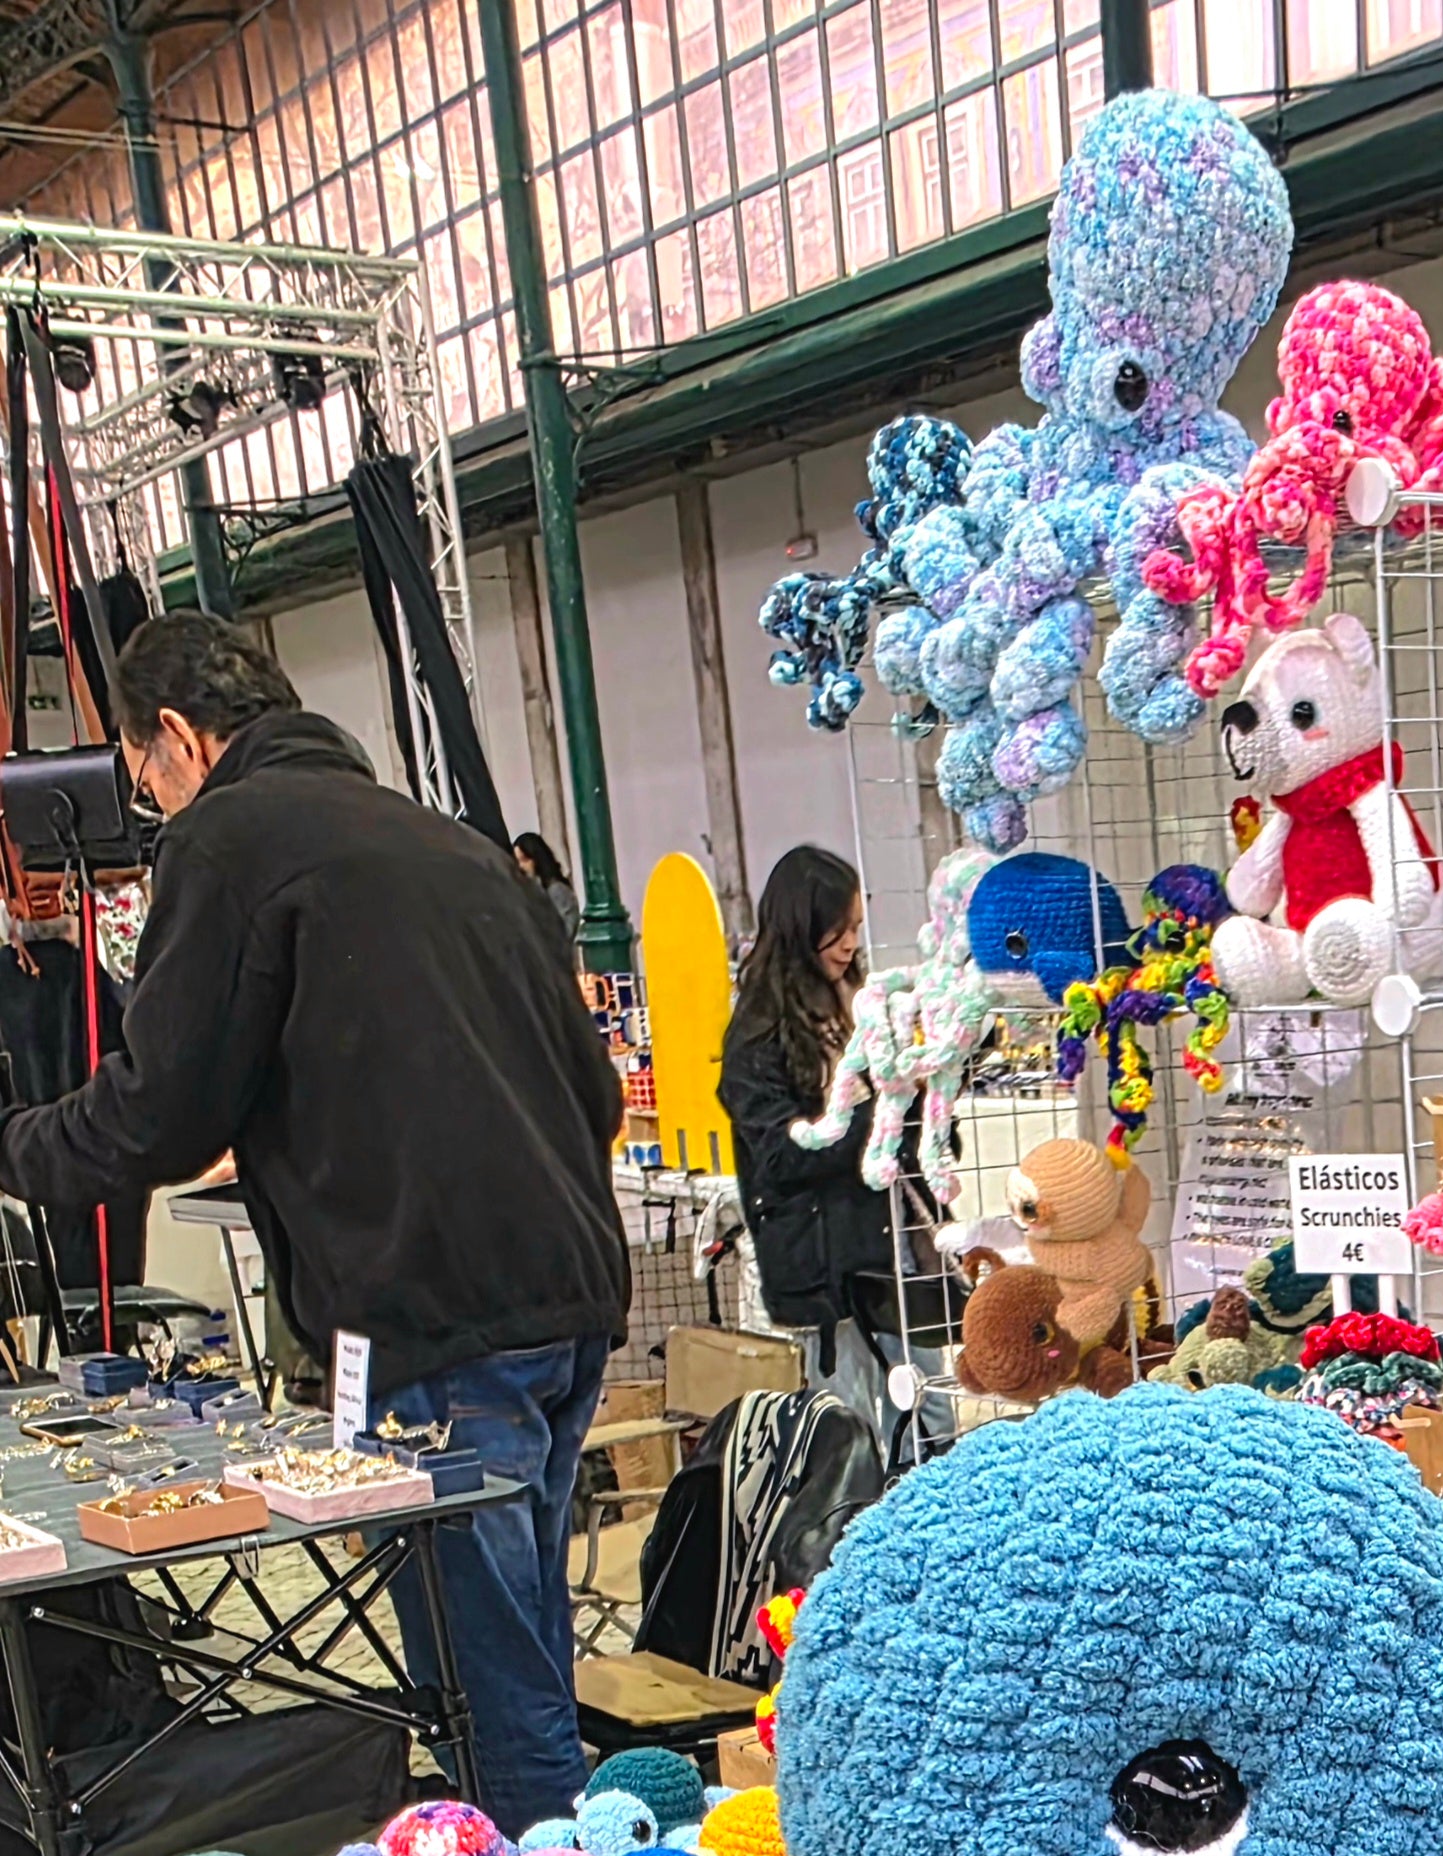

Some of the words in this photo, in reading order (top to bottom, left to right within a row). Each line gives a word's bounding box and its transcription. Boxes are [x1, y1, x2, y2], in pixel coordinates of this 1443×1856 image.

[1299, 1165, 1399, 1190] Elásticos
[1301, 1207, 1401, 1228] Scrunchies
[1342, 1243, 1364, 1262] 4€
